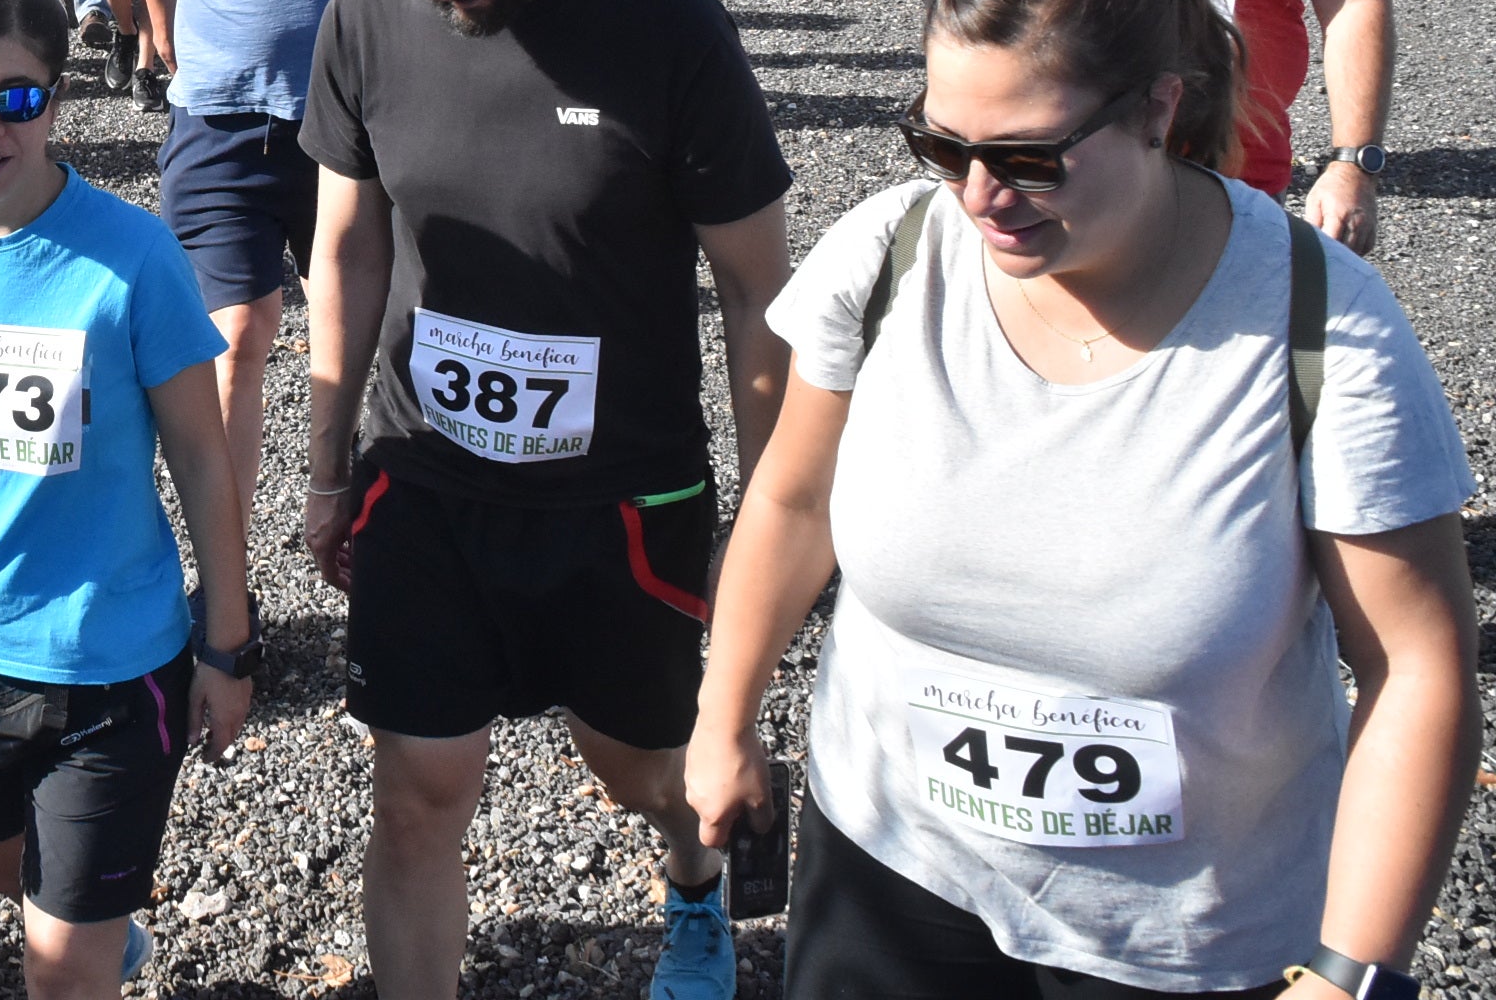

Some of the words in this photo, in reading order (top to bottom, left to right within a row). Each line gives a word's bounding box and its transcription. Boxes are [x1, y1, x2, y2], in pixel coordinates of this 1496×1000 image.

[556, 107, 600, 126] VANS
[428, 326, 494, 356] marcha
[431, 358, 569, 429] 387
[15, 436, 74, 466] BÉJAR
[424, 403, 488, 449] FUENTES
[493, 430, 517, 455] DE
[522, 433, 583, 456] BÉJAR
[924, 684, 1022, 721] marcha
[1031, 698, 1147, 733] benéfica
[942, 726, 1142, 804] 479
[927, 776, 1034, 833] FUENTES
[1041, 809, 1077, 837] DE
[1083, 807, 1174, 837] BÉJAR
